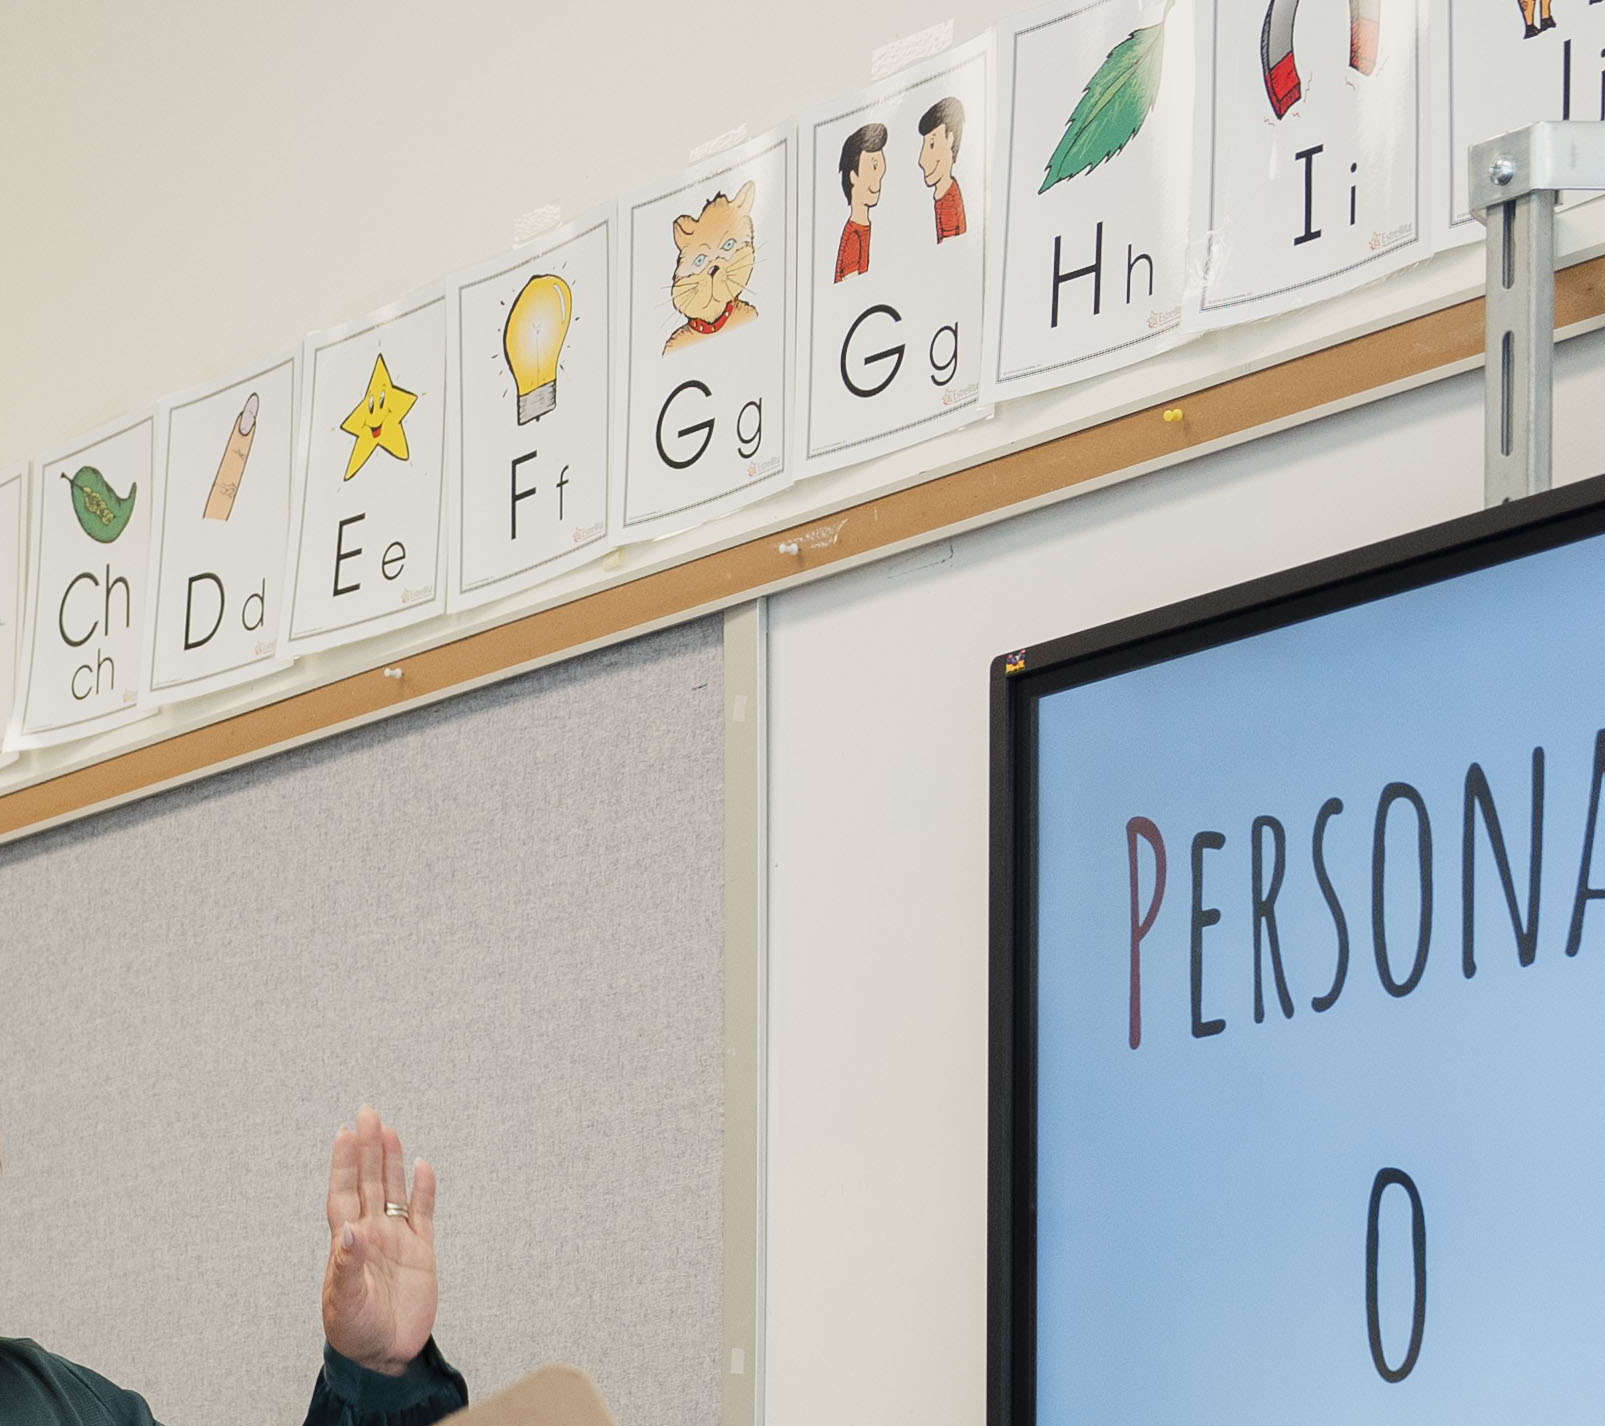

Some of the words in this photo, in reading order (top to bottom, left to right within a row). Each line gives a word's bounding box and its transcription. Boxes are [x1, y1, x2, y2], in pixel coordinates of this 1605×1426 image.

[59, 562, 131, 647] Ch
[71, 648, 115, 700] ch
[1365, 1166, 1428, 1384] O
